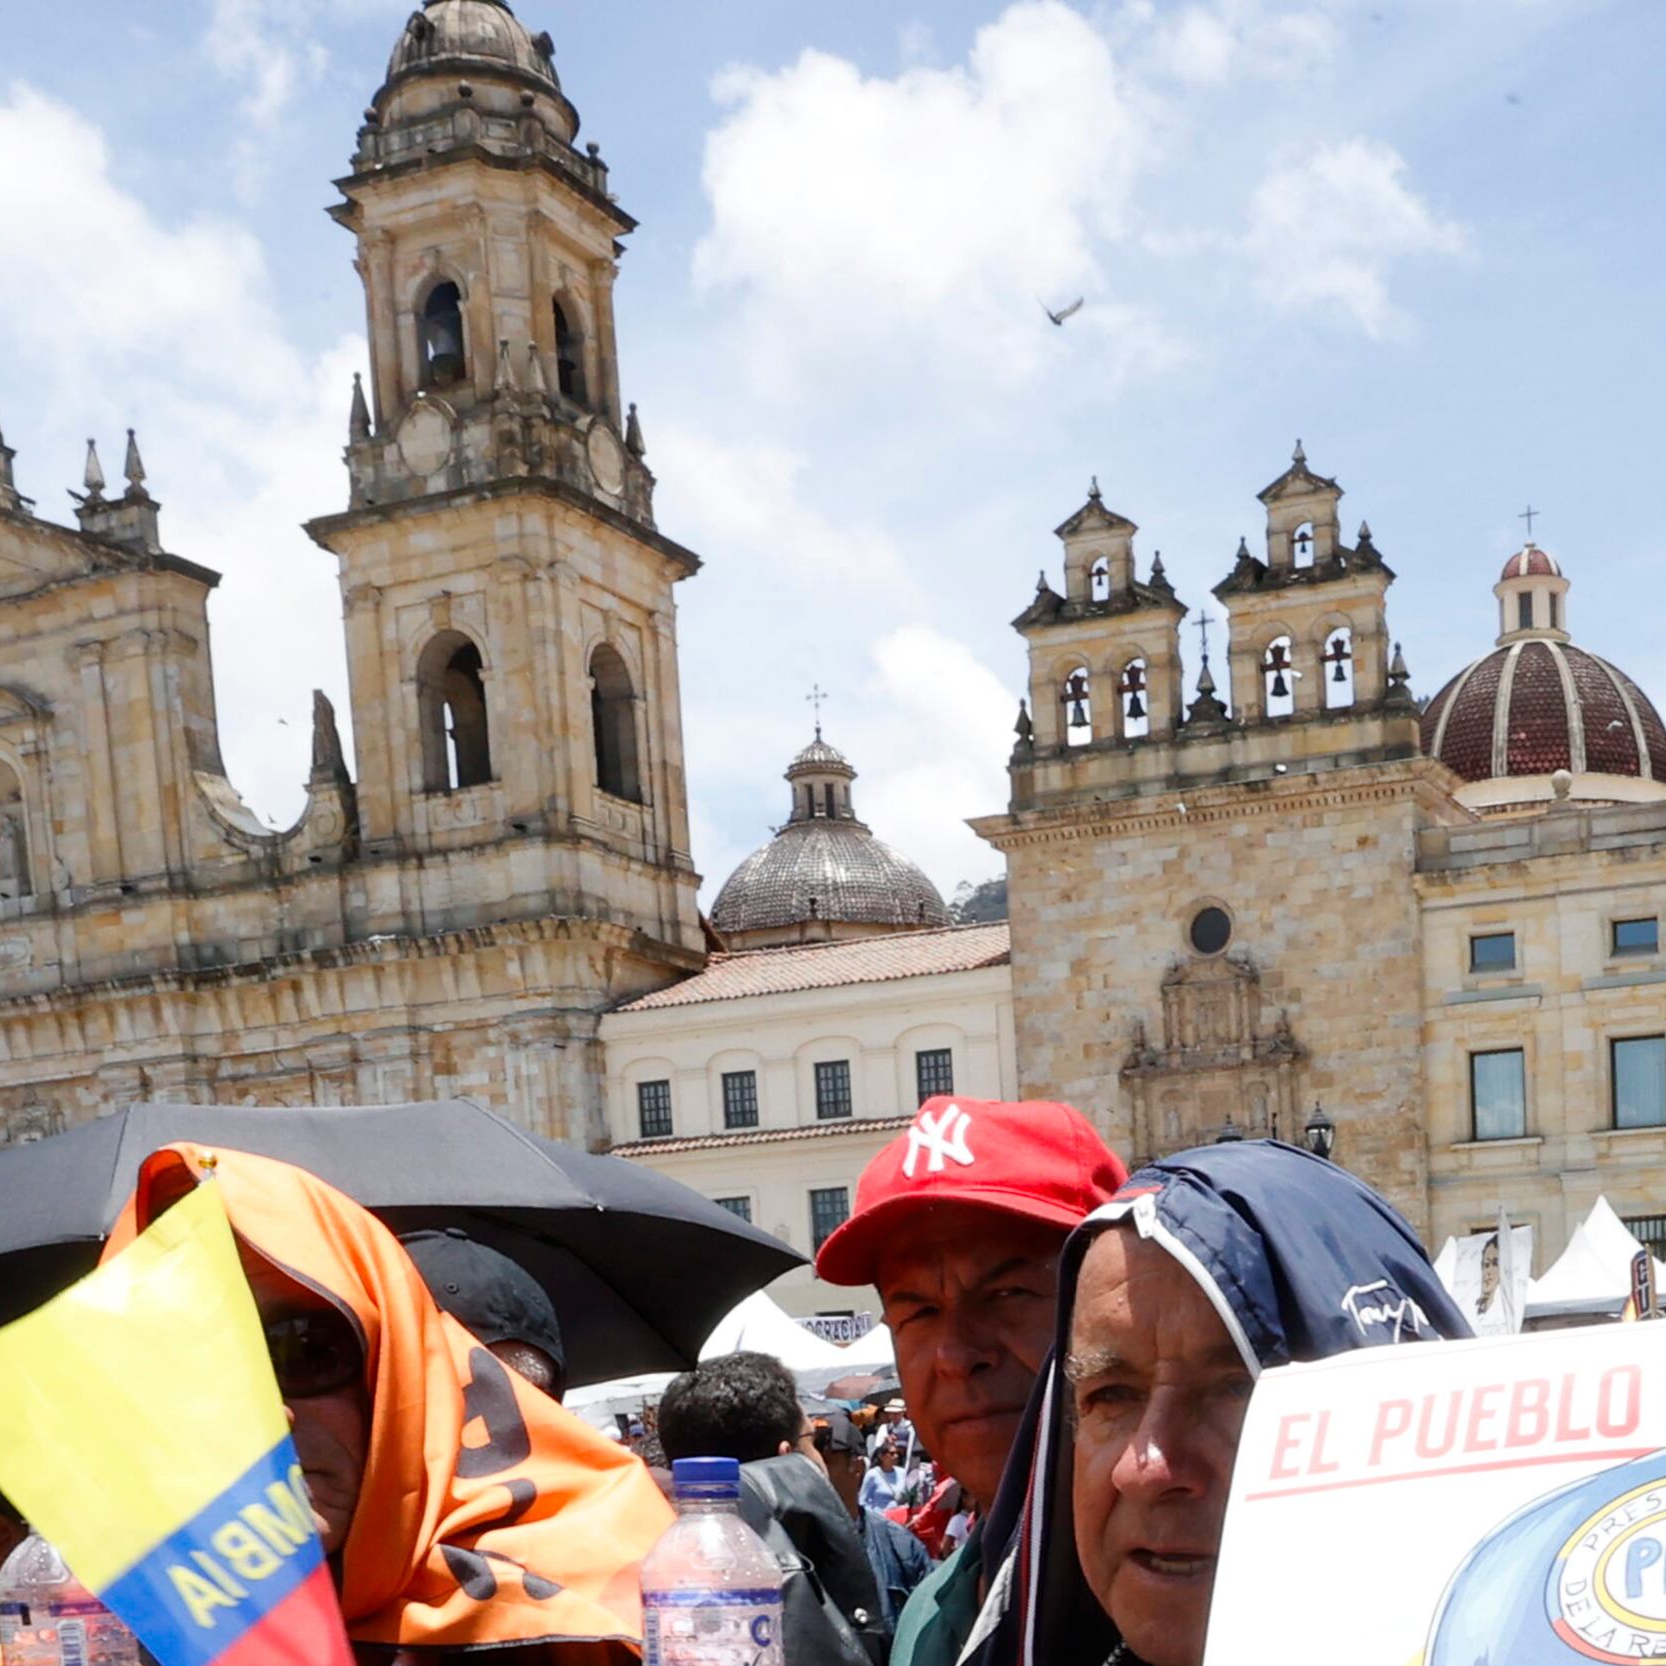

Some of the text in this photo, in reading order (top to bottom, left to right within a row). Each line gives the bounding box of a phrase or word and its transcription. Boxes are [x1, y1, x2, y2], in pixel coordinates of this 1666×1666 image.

[902, 1103, 975, 1178] NY
[1268, 1412, 1342, 1481] EL
[1368, 1364, 1642, 1468] PUEBLO
[1564, 1578, 1591, 1618] DE
[1579, 1619, 1619, 1649] LA
